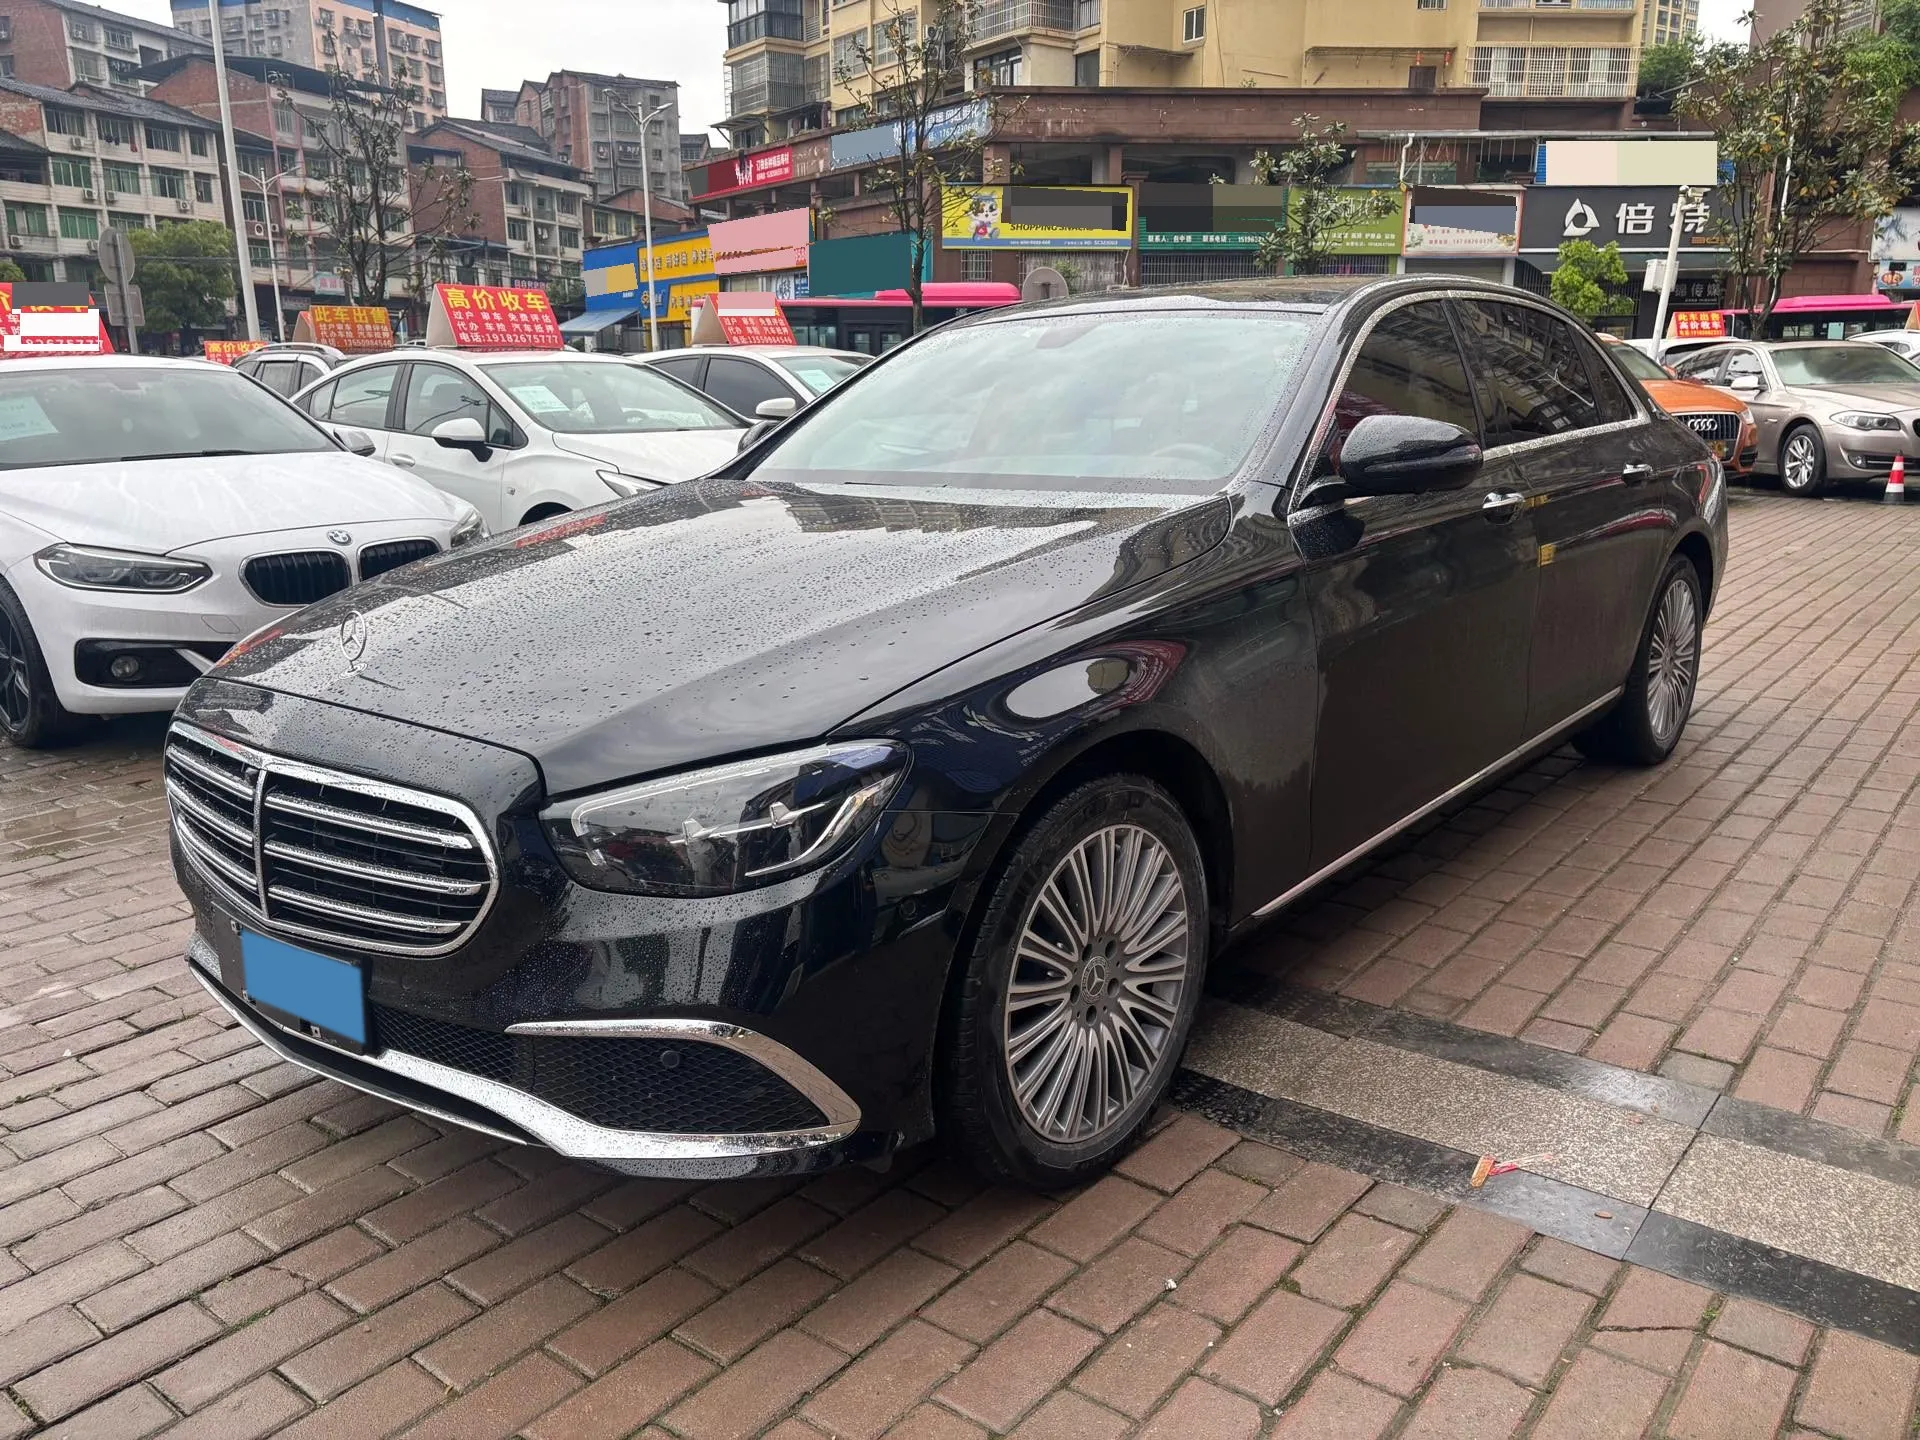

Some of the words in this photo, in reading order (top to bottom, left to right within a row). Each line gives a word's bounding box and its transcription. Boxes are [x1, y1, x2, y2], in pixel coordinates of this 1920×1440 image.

[444, 288, 548, 312] 高价收车
[315, 307, 387, 324] 此车出售
